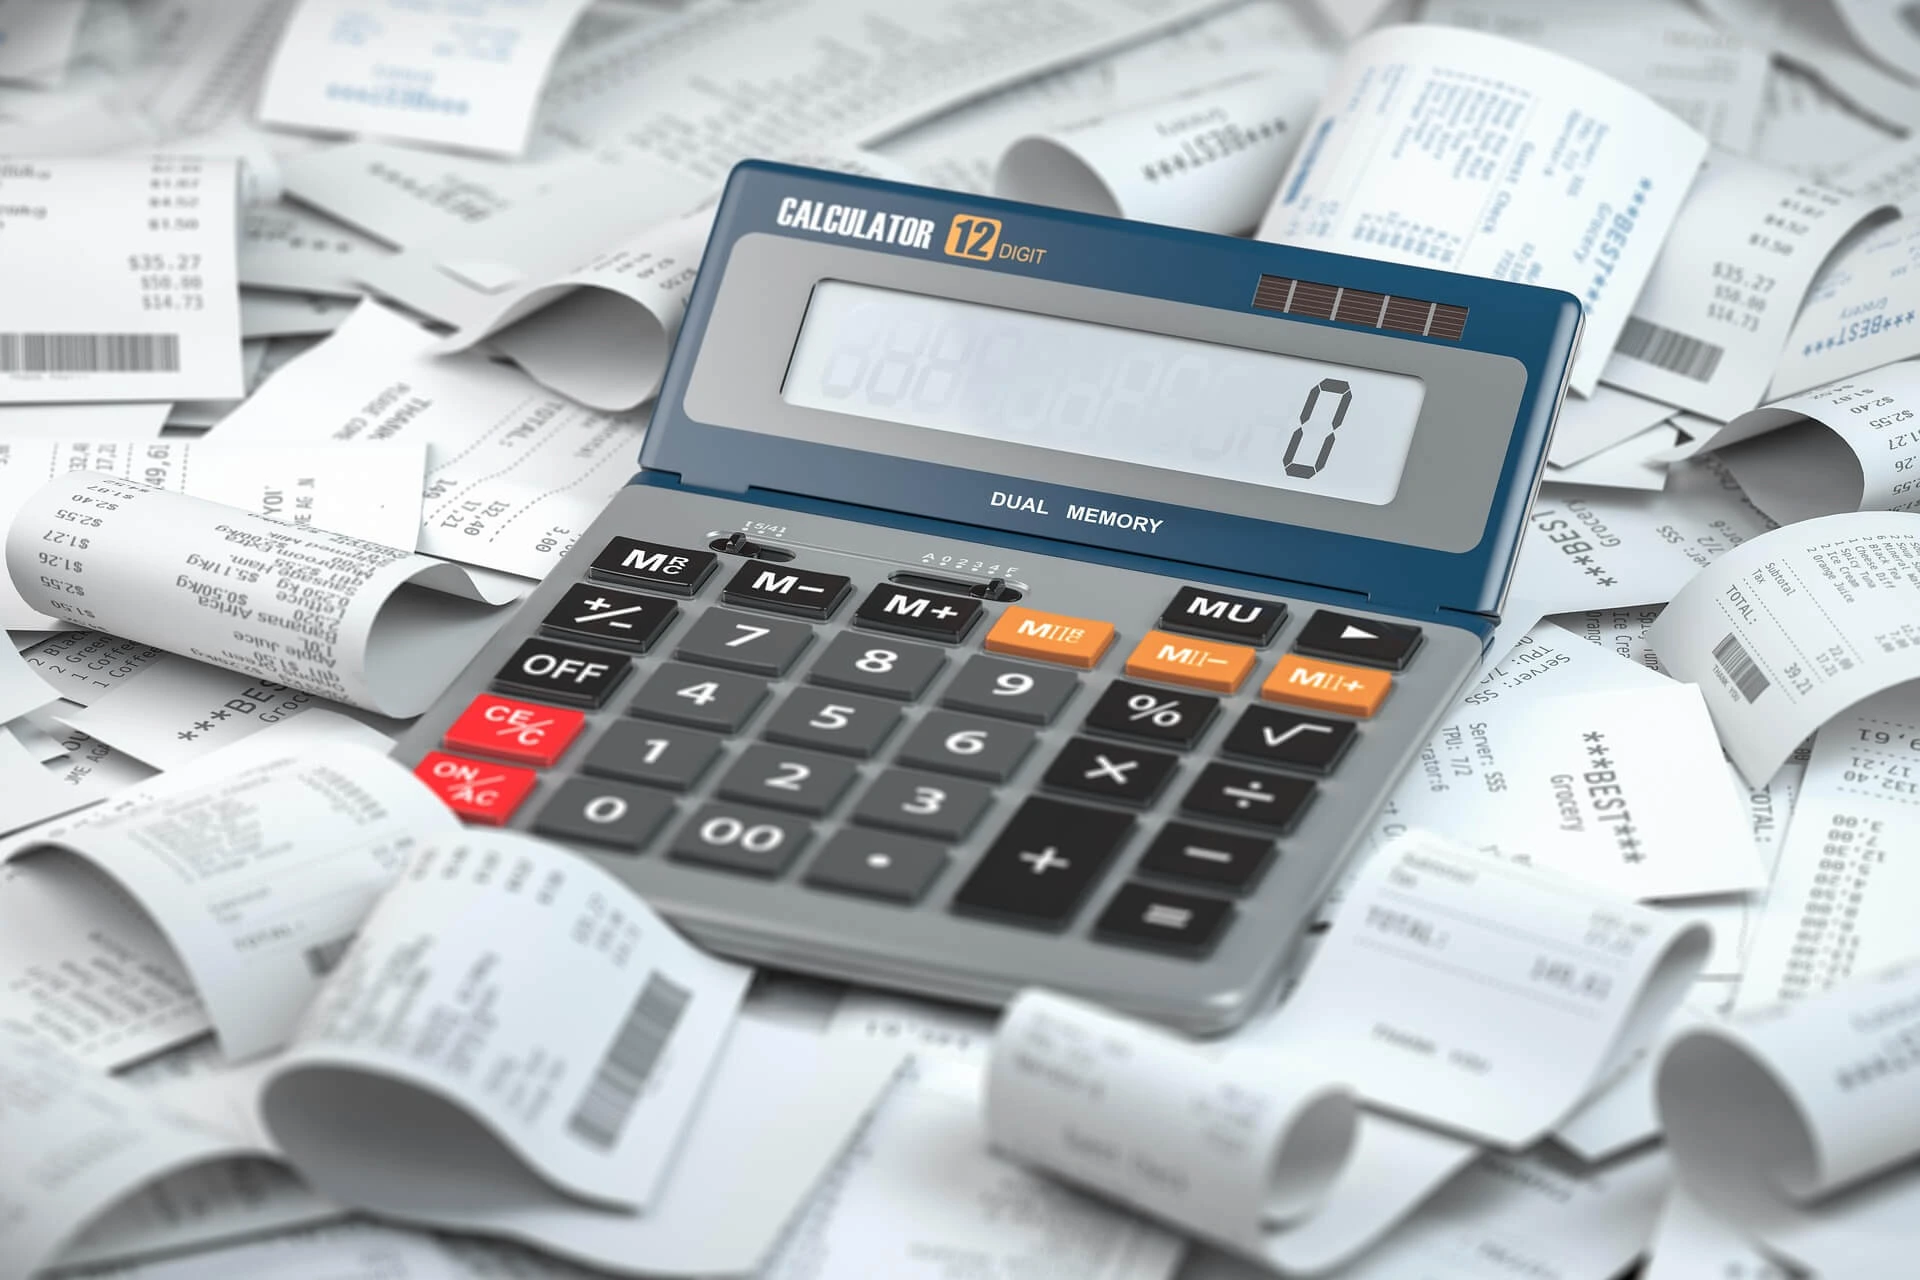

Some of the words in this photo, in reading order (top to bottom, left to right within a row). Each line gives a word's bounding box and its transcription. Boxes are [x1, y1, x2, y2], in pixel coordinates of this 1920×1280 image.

[777, 197, 935, 250] CALCULATOR
[948, 218, 998, 259] 12
[999, 243, 1048, 265] DIGIT
[128, 254, 201, 272] $35.27
[1282, 378, 1352, 480] 0
[1868, 408, 1915, 430] $2.55
[1887, 430, 1920, 451] 1.27
[71, 493, 119, 512] $2.40
[990, 491, 1049, 515] DUAL
[1066, 504, 1164, 535] MEMORY
[55, 508, 104, 529] $2.55
[42, 529, 91, 551] $1.27
[38, 551, 84, 573] $1.26
[186, 554, 259, 583] $5.11/kg
[40, 575, 85, 598] $2.55
[1751, 568, 1766, 585] Tax
[1765, 562, 1797, 597] Subtotal
[1813, 554, 1837, 581] Orange
[1833, 579, 1856, 604] Juice
[176, 575, 248, 606] $0.50/kg
[198, 596, 252, 619] Africa
[1187, 597, 1263, 624] MU
[258, 612, 337, 645] Bananas
[725, 624, 771, 646] 7
[1725, 584, 1758, 625] TOTAL:
[1783, 662, 1815, 696] 39,21
[855, 650, 899, 673] 8
[1510, 645, 1555, 666] TPU:
[522, 654, 609, 684] OFF
[1506, 654, 1571, 689] Server:
[677, 682, 720, 705] 4
[992, 674, 1035, 696] 9
[1464, 688, 1499, 707] SSS
[809, 704, 855, 729] 5
[945, 731, 989, 755] 6
[1441, 725, 1464, 750] TPU:
[1469, 722, 1495, 768] Server:
[643, 739, 670, 764] 1
[764, 762, 811, 791] 2
[1851, 756, 1913, 778] 17,21
[1844, 769, 1918, 795] 132,40
[583, 796, 628, 824] 0
[901, 786, 947, 815] 3
[1550, 774, 1586, 833] Grocery
[700, 817, 784, 852] 00
